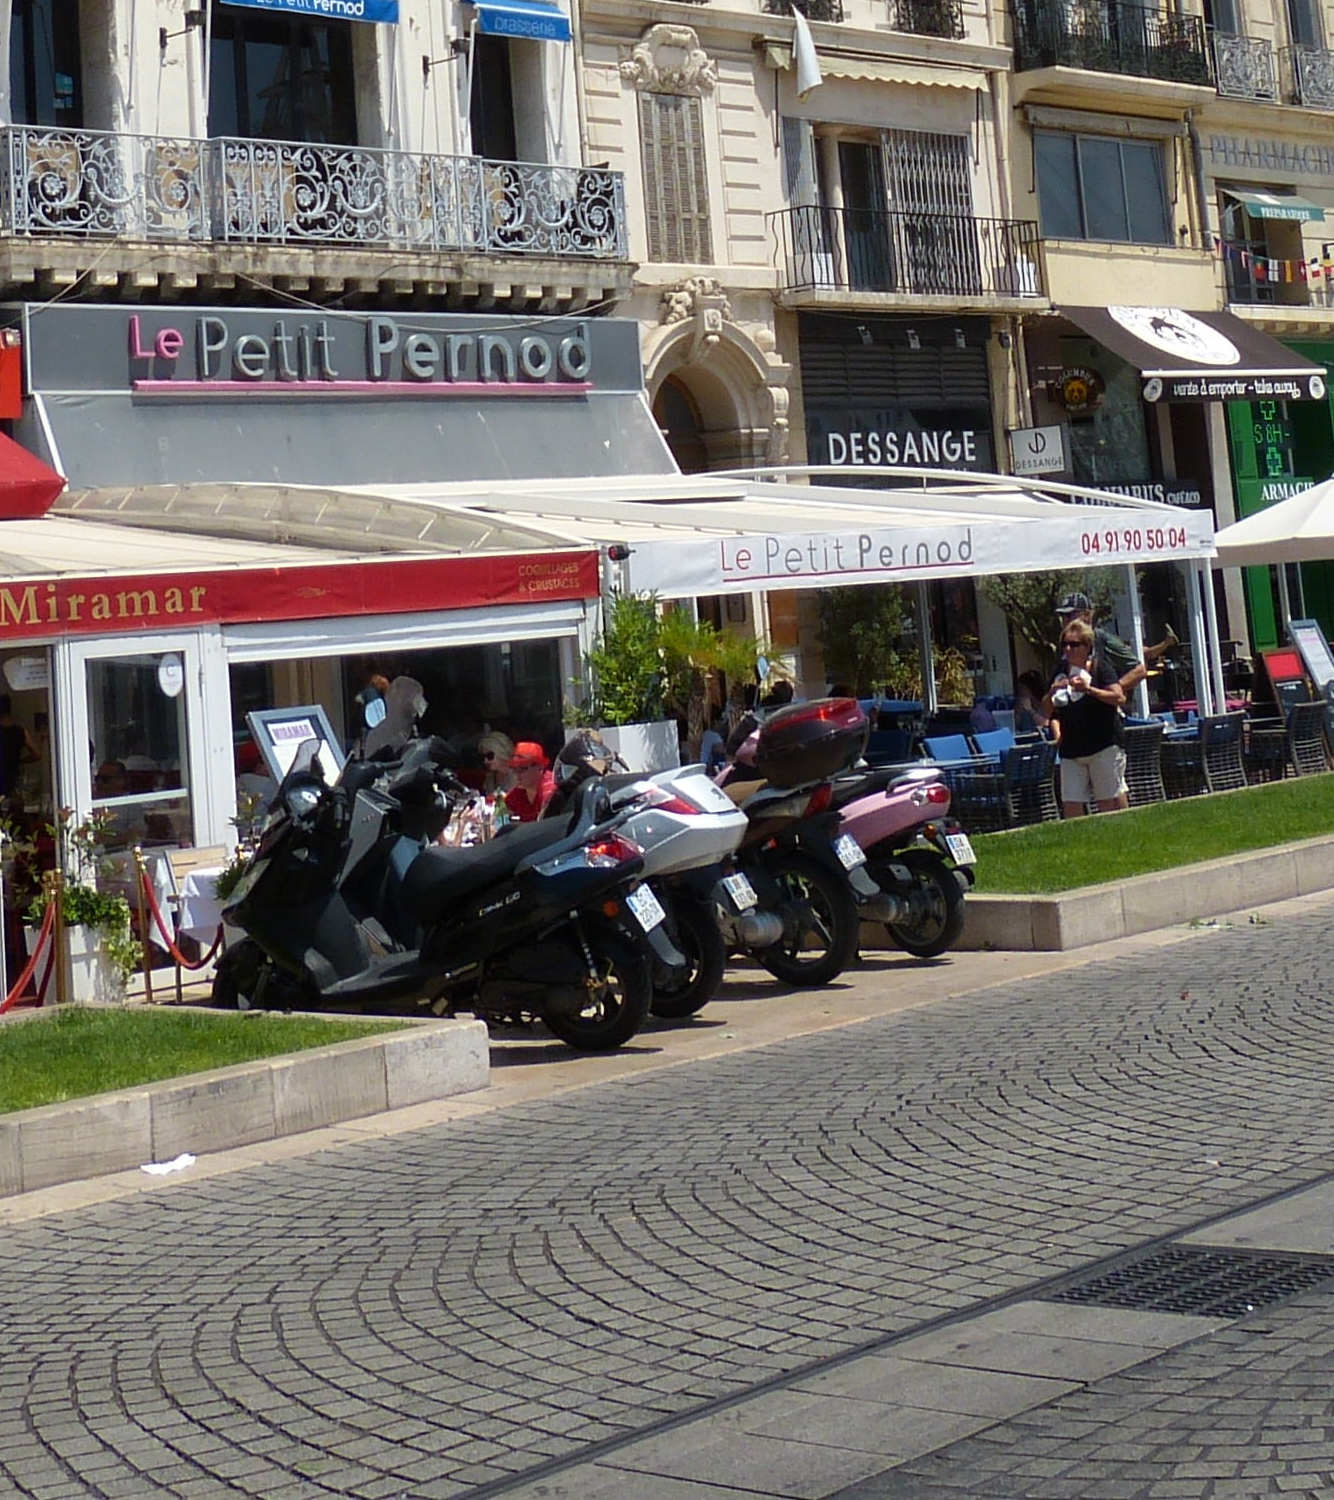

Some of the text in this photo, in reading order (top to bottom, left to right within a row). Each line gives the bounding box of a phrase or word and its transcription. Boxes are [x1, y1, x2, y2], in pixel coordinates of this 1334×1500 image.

[129, 314, 592, 379] Le Petit Pernod
[1173, 382, 1199, 396] vente
[1208, 379, 1247, 399] emporter
[828, 430, 976, 465] DESSANGE
[1016, 455, 1063, 470] DESSANGE
[721, 527, 972, 574] Le Petit Pernod
[1081, 532, 1100, 554] 04
[1105, 530, 1119, 552] 91
[1124, 529, 1142, 551] 90
[1147, 528, 1164, 550] 50
[1168, 527, 1186, 548] 04
